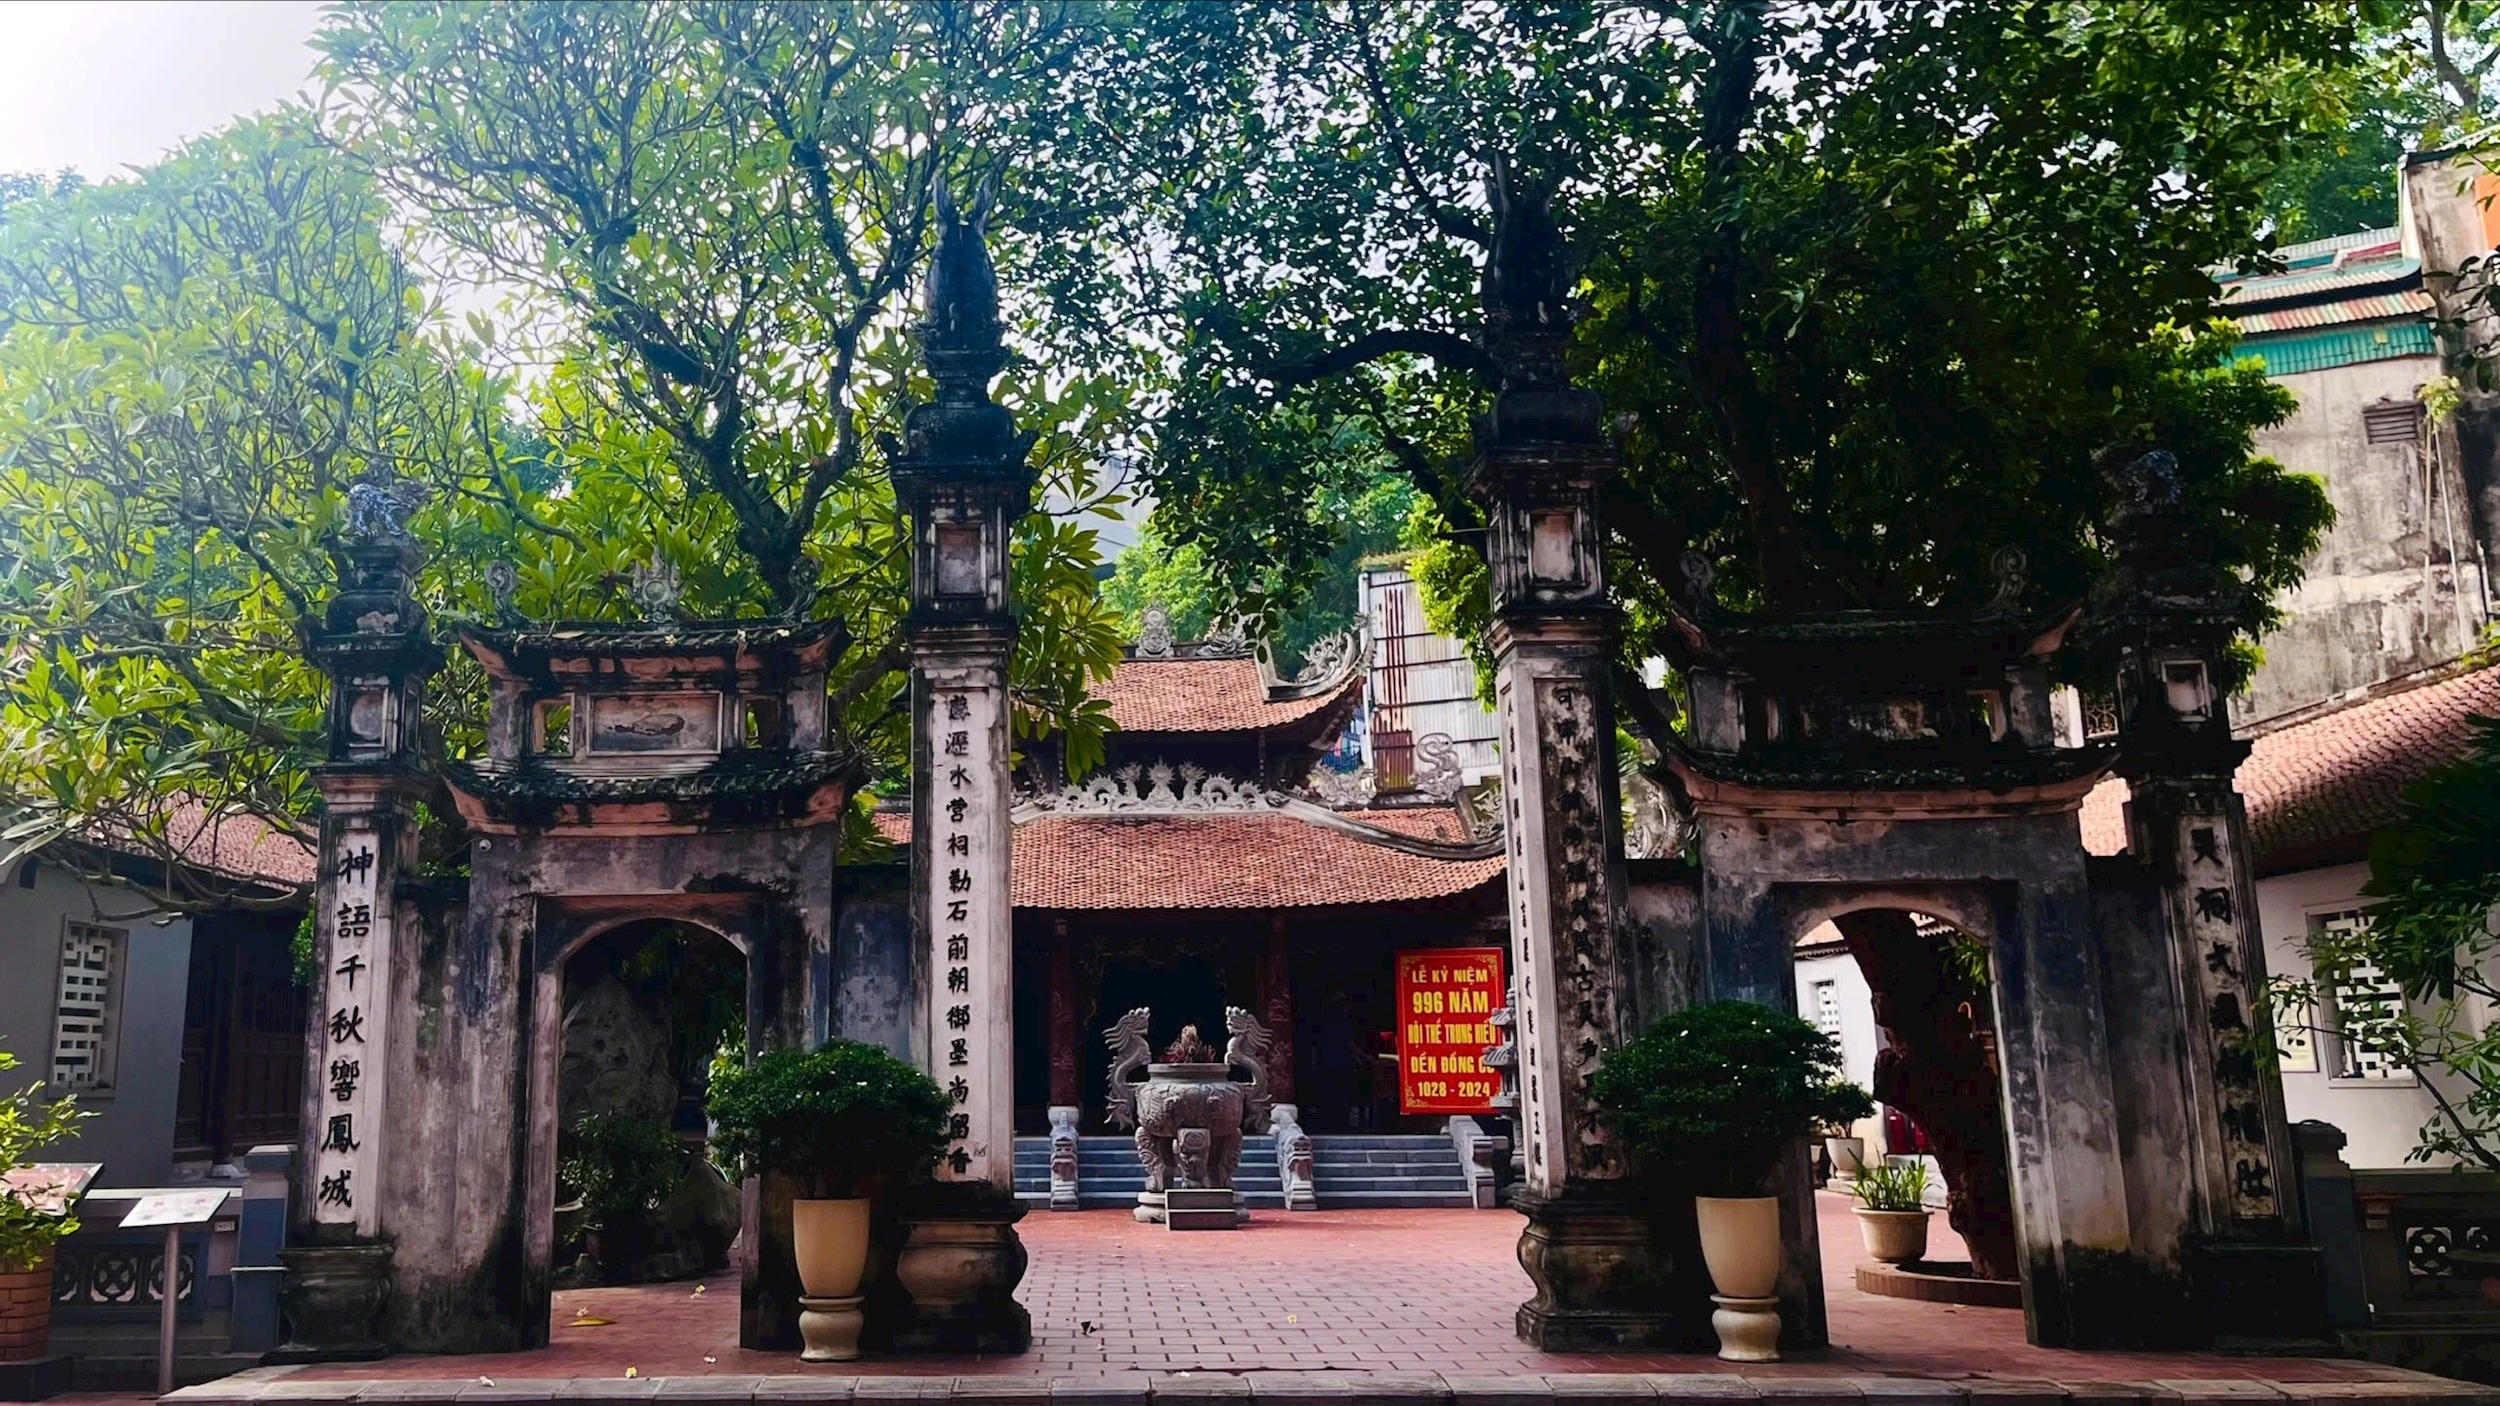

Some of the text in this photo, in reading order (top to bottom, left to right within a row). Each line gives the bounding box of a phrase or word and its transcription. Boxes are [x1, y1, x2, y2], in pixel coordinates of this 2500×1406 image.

[1432, 965, 1448, 983] KỶ
[1453, 966, 1488, 985] NIỆM
[1413, 988, 1489, 1014] 996 NĂM
[319, 845, 374, 1208] 神語千秋響鳳城
[1445, 1024, 1473, 1044] TRUNG
[1418, 1081, 1447, 1097] 1028
[1458, 1081, 1490, 1097] 2024
